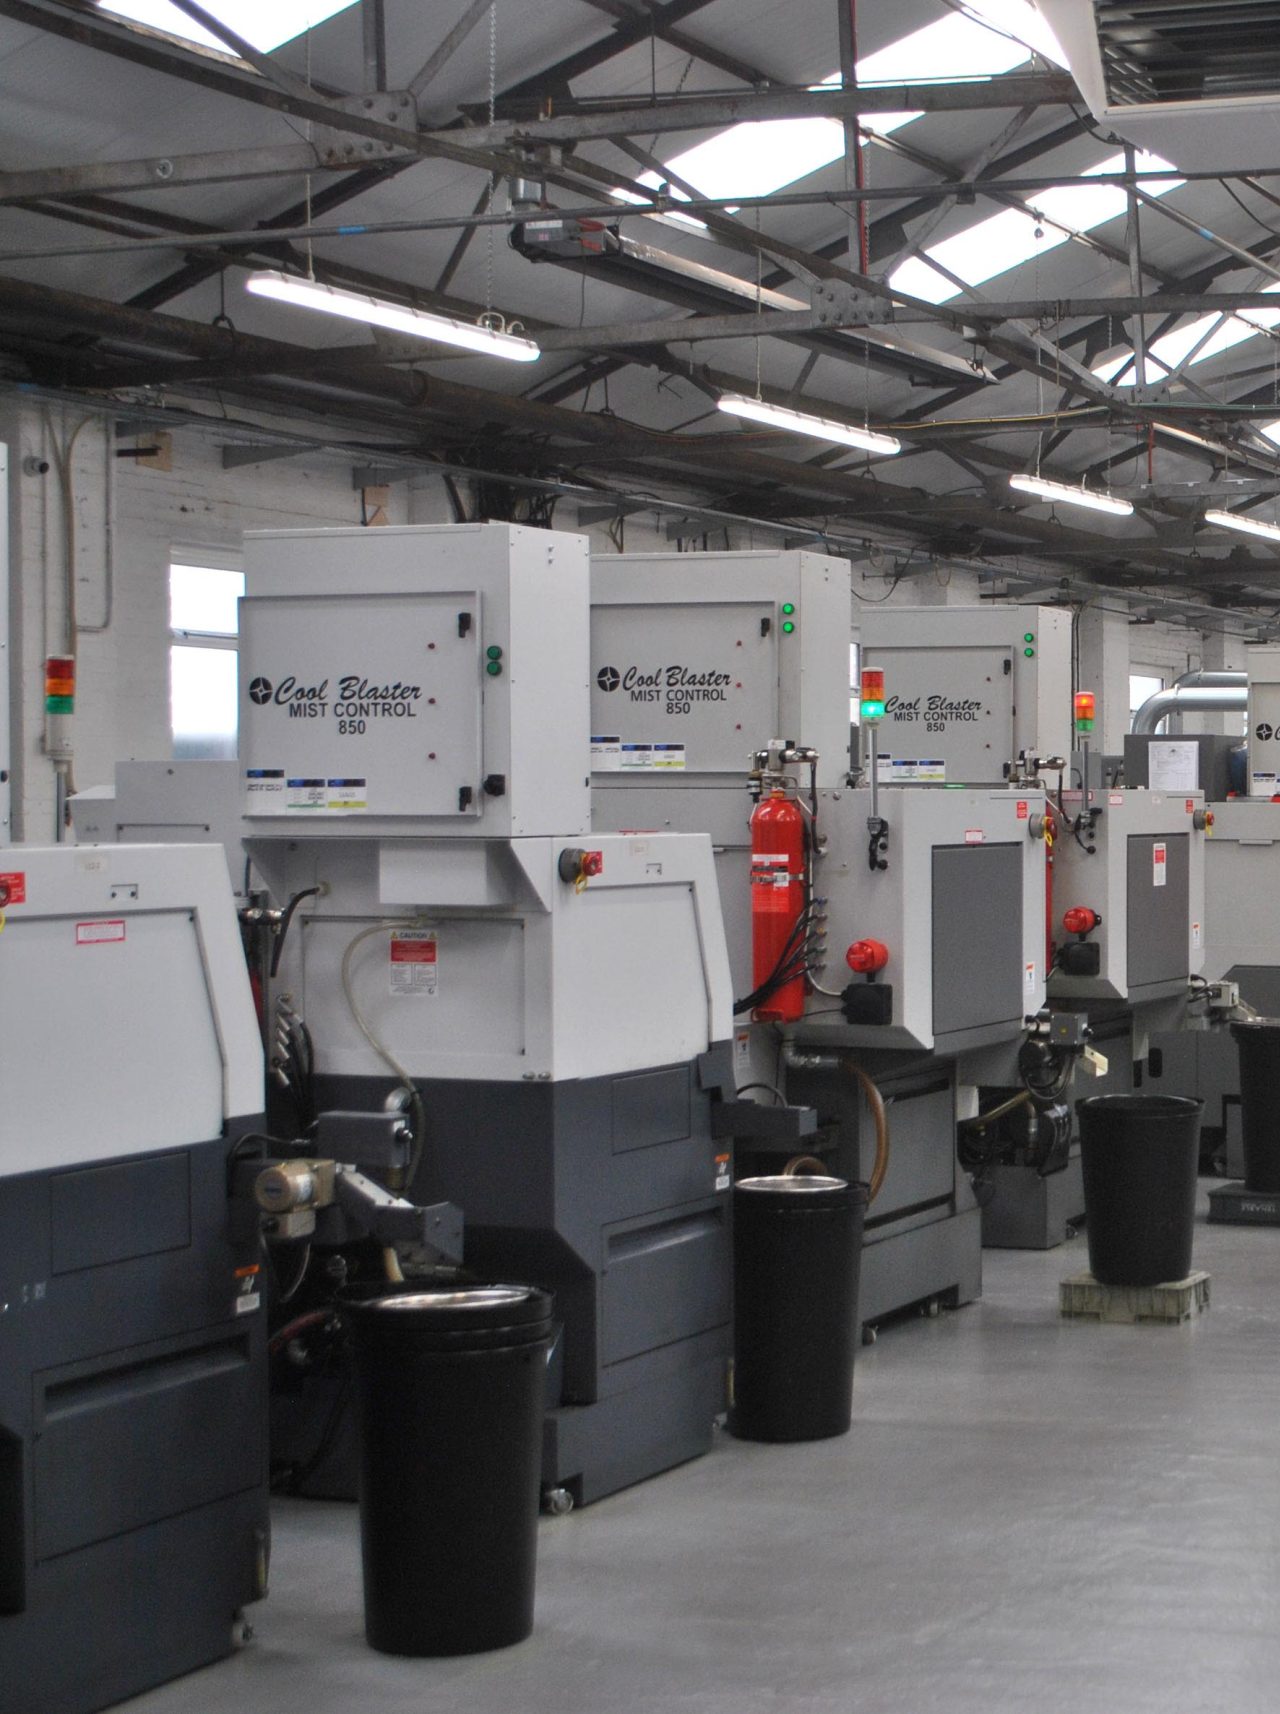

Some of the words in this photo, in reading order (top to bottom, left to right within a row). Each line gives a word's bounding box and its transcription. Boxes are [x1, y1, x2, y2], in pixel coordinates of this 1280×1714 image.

[623, 665, 663, 691] Cool
[665, 665, 732, 687] Blaster
[274, 676, 329, 705] Cool
[338, 676, 423, 701] Blaster
[630, 690, 662, 701] MIST
[666, 689, 727, 701] CONTROL
[289, 703, 328, 717] MIST
[333, 702, 417, 717] CONTROL
[666, 702, 691, 714] 850
[884, 695, 921, 714] Cool
[926, 695, 982, 711] Blaster
[894, 711, 920, 721] MIST
[923, 711, 979, 721] CONTROL
[338, 719, 366, 734] 850
[926, 722, 945, 732] 850
